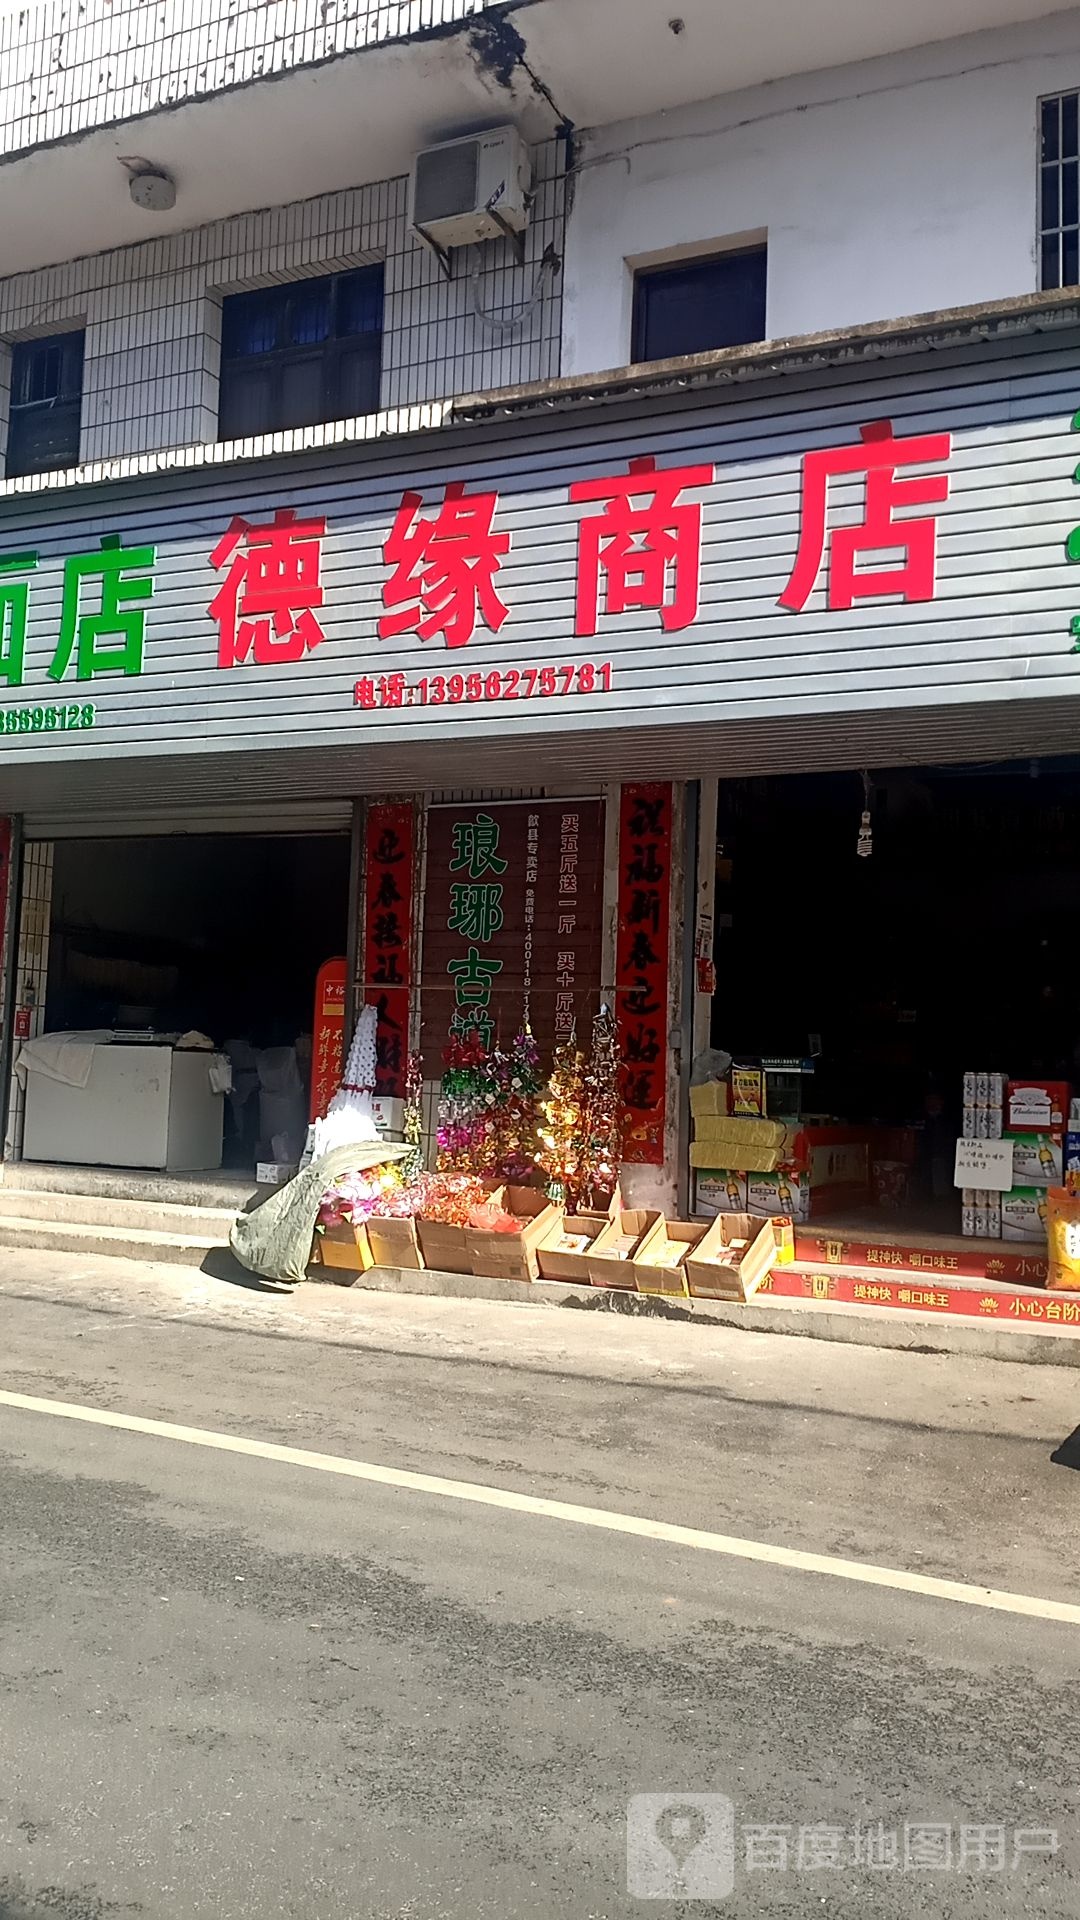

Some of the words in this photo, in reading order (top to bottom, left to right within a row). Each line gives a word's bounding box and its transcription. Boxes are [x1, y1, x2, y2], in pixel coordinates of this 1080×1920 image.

[207, 419, 952, 669] 德缘商店
[525, 814, 540, 883] 歙县专卖店
[557, 814, 579, 934] 买五斤送一斤
[866, 1249, 903, 1265] 提神快
[908, 1252, 959, 1270] 嚼口味王
[853, 1283, 892, 1302] 提神快
[897, 1288, 950, 1308] 嚼口味王
[1009, 1297, 1080, 1322] 小心台阶
